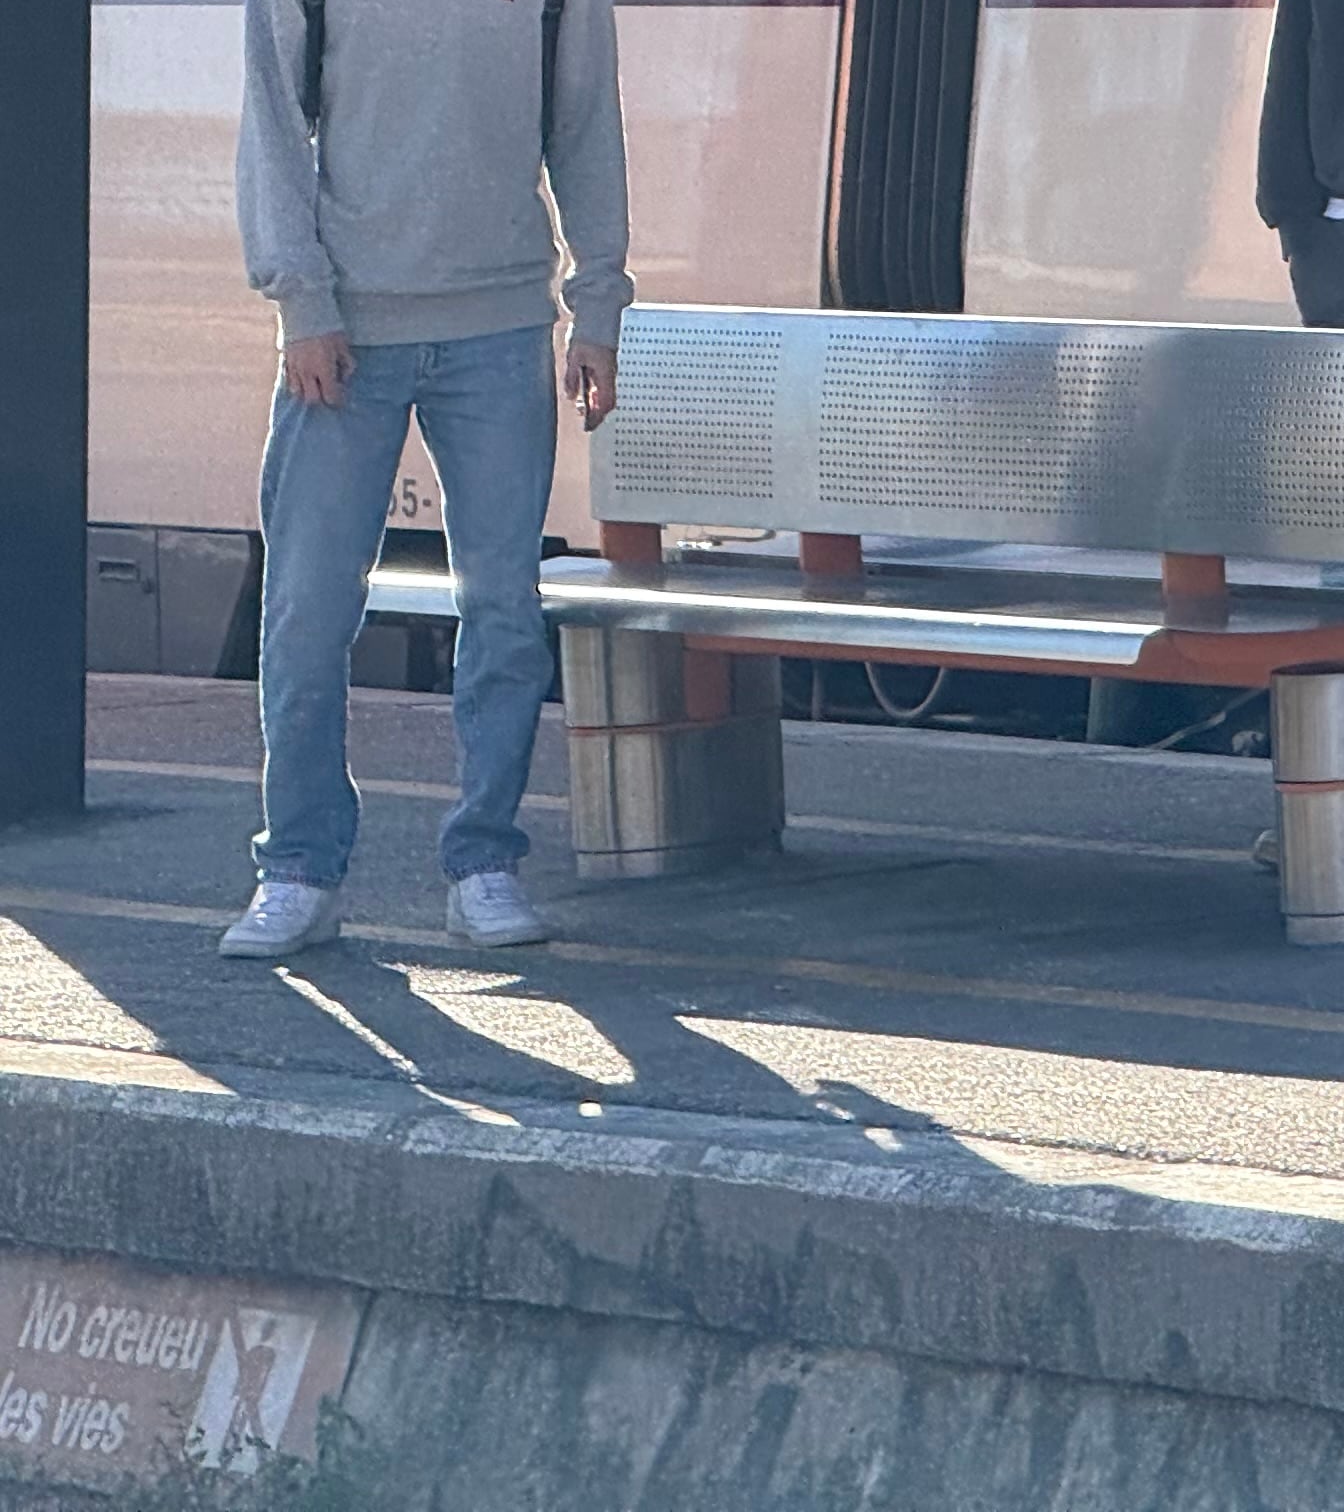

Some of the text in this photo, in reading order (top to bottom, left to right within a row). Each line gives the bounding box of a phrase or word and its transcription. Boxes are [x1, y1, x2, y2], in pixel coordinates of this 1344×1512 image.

[18, 1282, 209, 1370] No creueu
[0, 1370, 130, 1454] les vies
